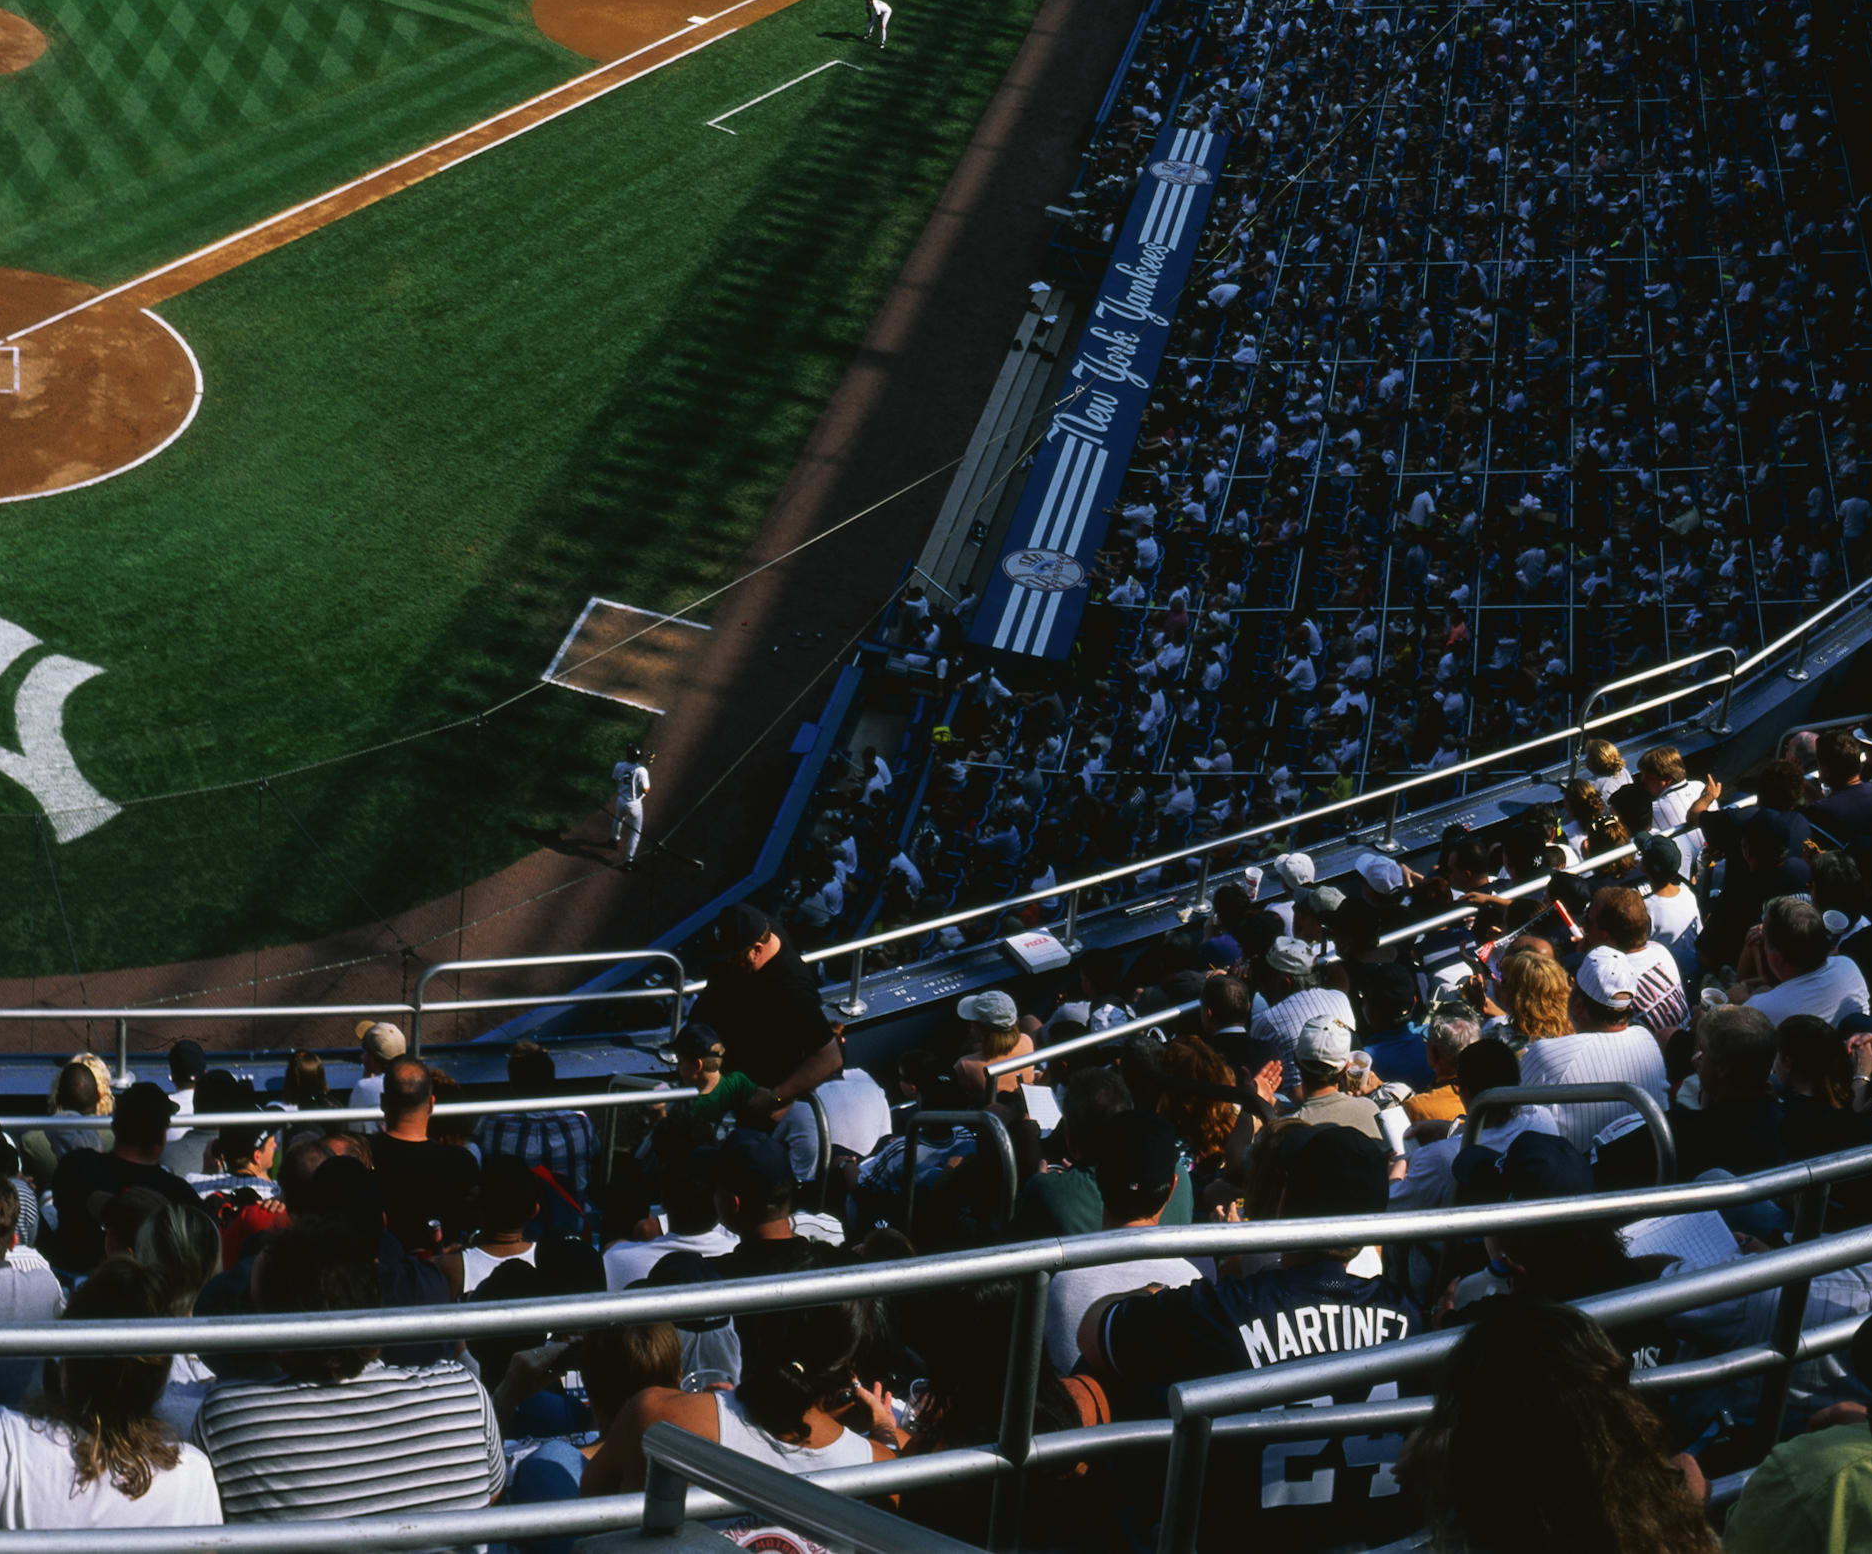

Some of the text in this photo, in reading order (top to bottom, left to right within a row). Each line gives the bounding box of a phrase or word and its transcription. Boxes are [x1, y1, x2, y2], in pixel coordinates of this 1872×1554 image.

[1046, 242, 1170, 446] New York Yankees
[1024, 937, 1050, 949] PIZZA
